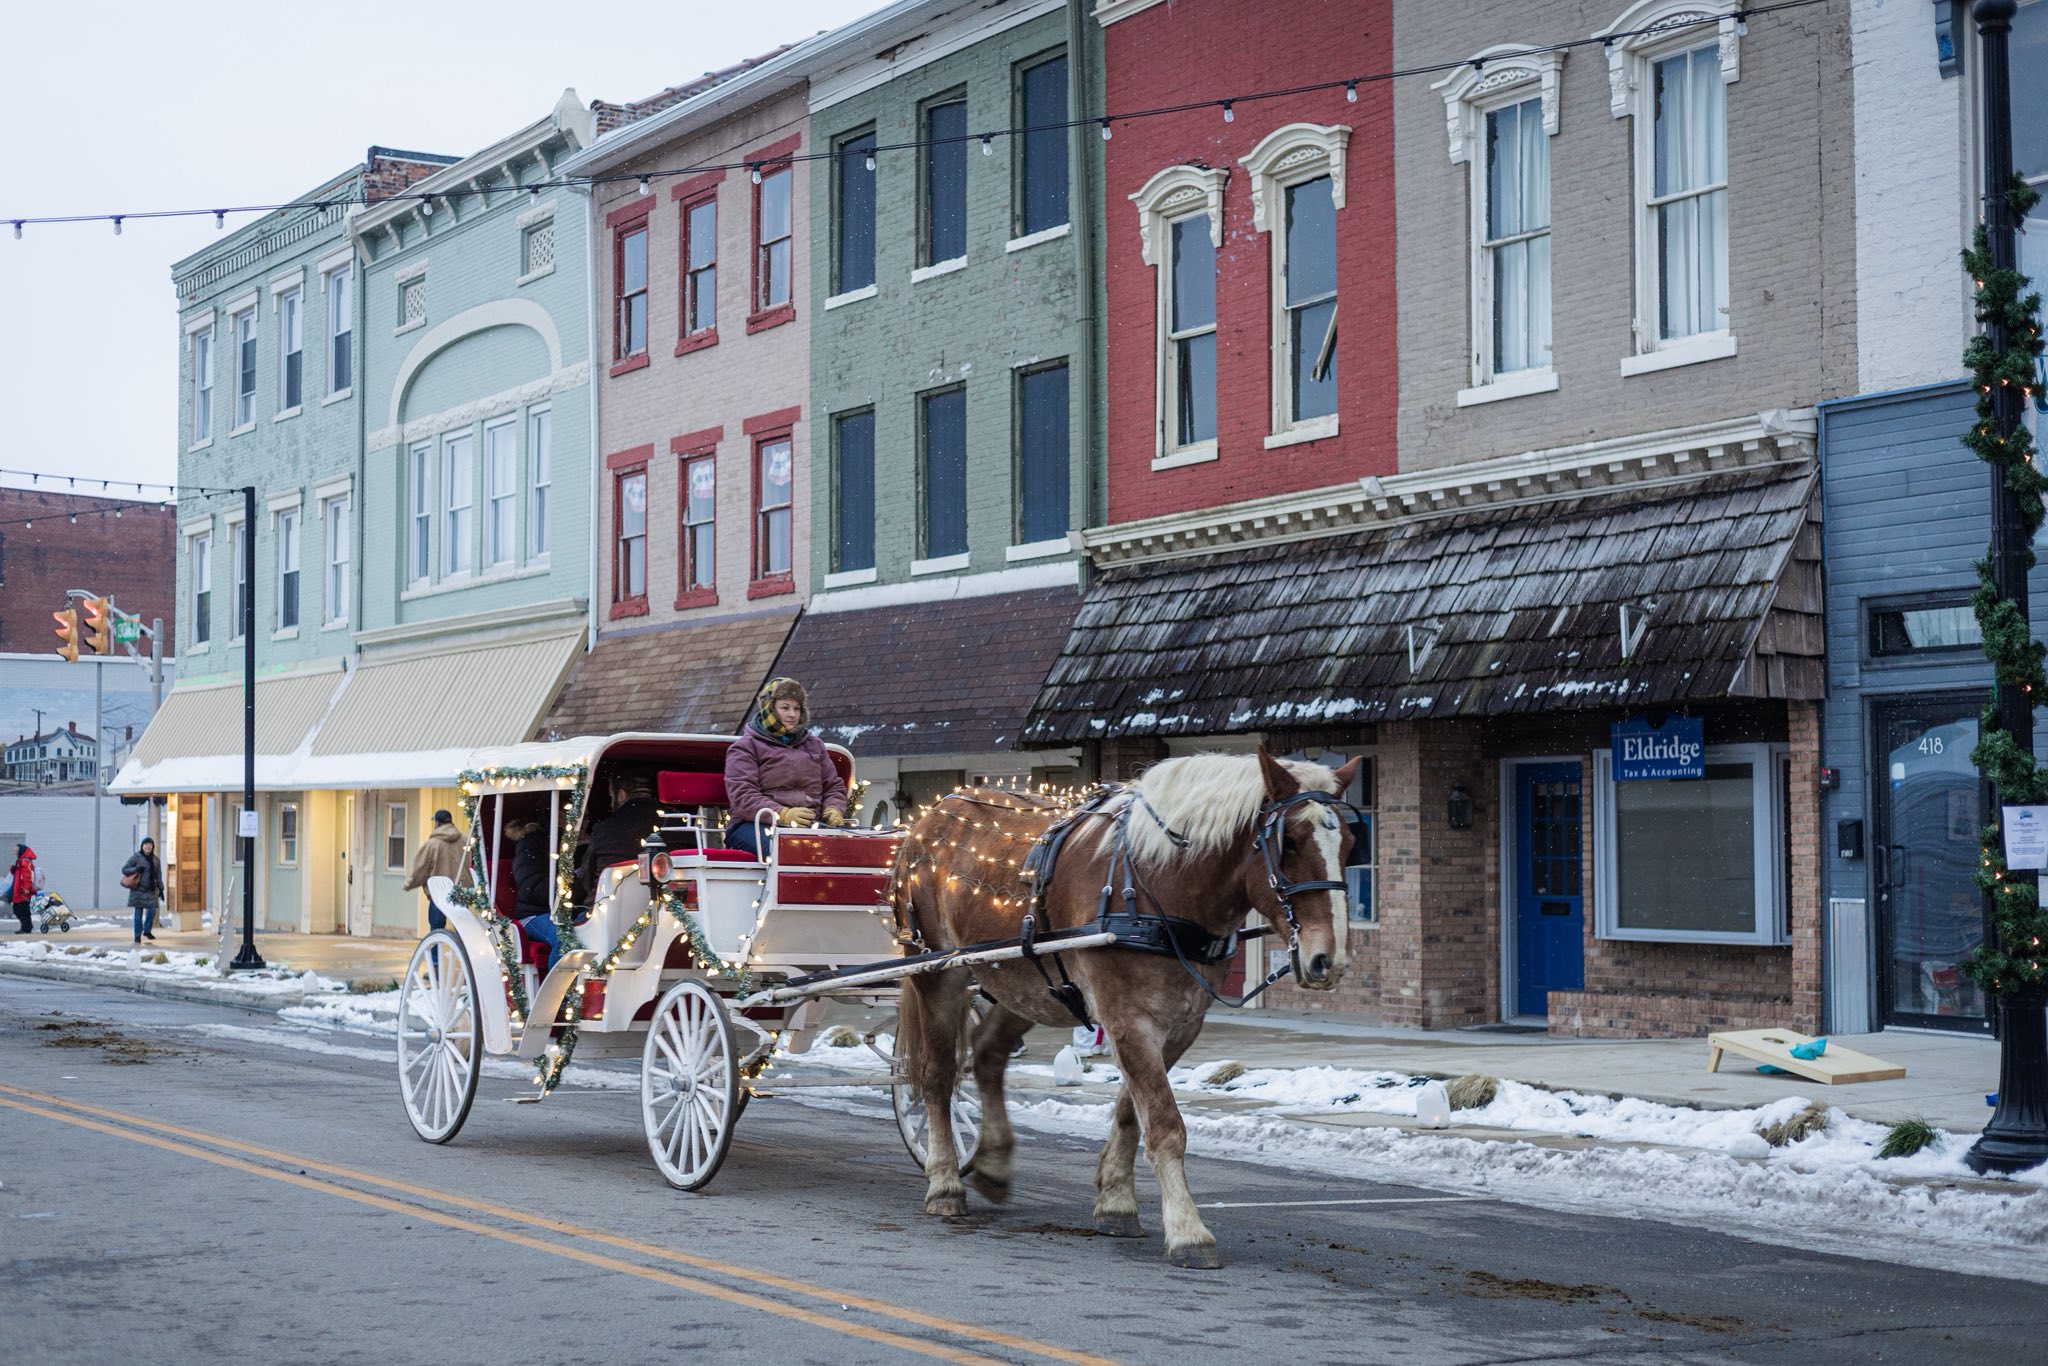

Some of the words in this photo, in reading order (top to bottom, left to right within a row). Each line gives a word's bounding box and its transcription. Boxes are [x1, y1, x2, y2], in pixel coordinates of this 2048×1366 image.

[1623, 735, 1700, 766] Eldridge
[1918, 737, 1944, 755] 418
[1624, 769, 1639, 778] Tax
[1642, 768, 1648, 777] &
[1651, 766, 1702, 777] Accounting
